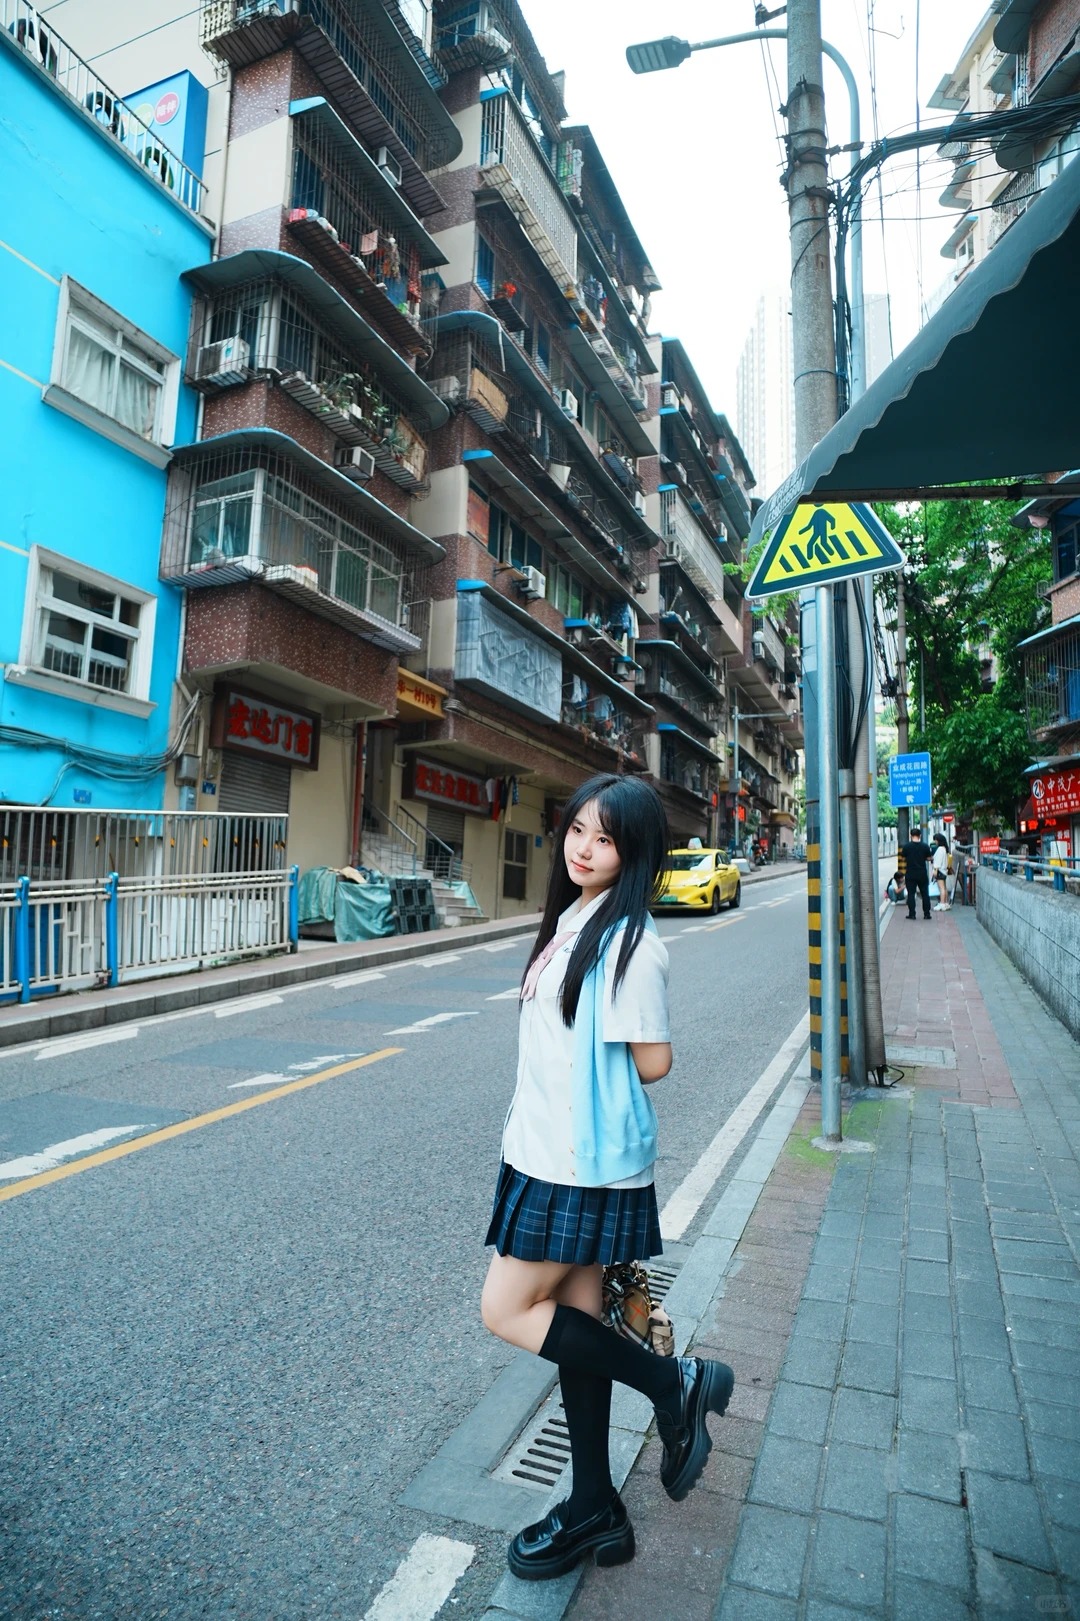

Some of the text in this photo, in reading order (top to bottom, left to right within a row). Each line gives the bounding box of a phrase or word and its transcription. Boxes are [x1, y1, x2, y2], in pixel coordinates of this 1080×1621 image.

[228, 698, 313, 757] 宏达门窗
[1047, 773, 1080, 794] 中茂广
